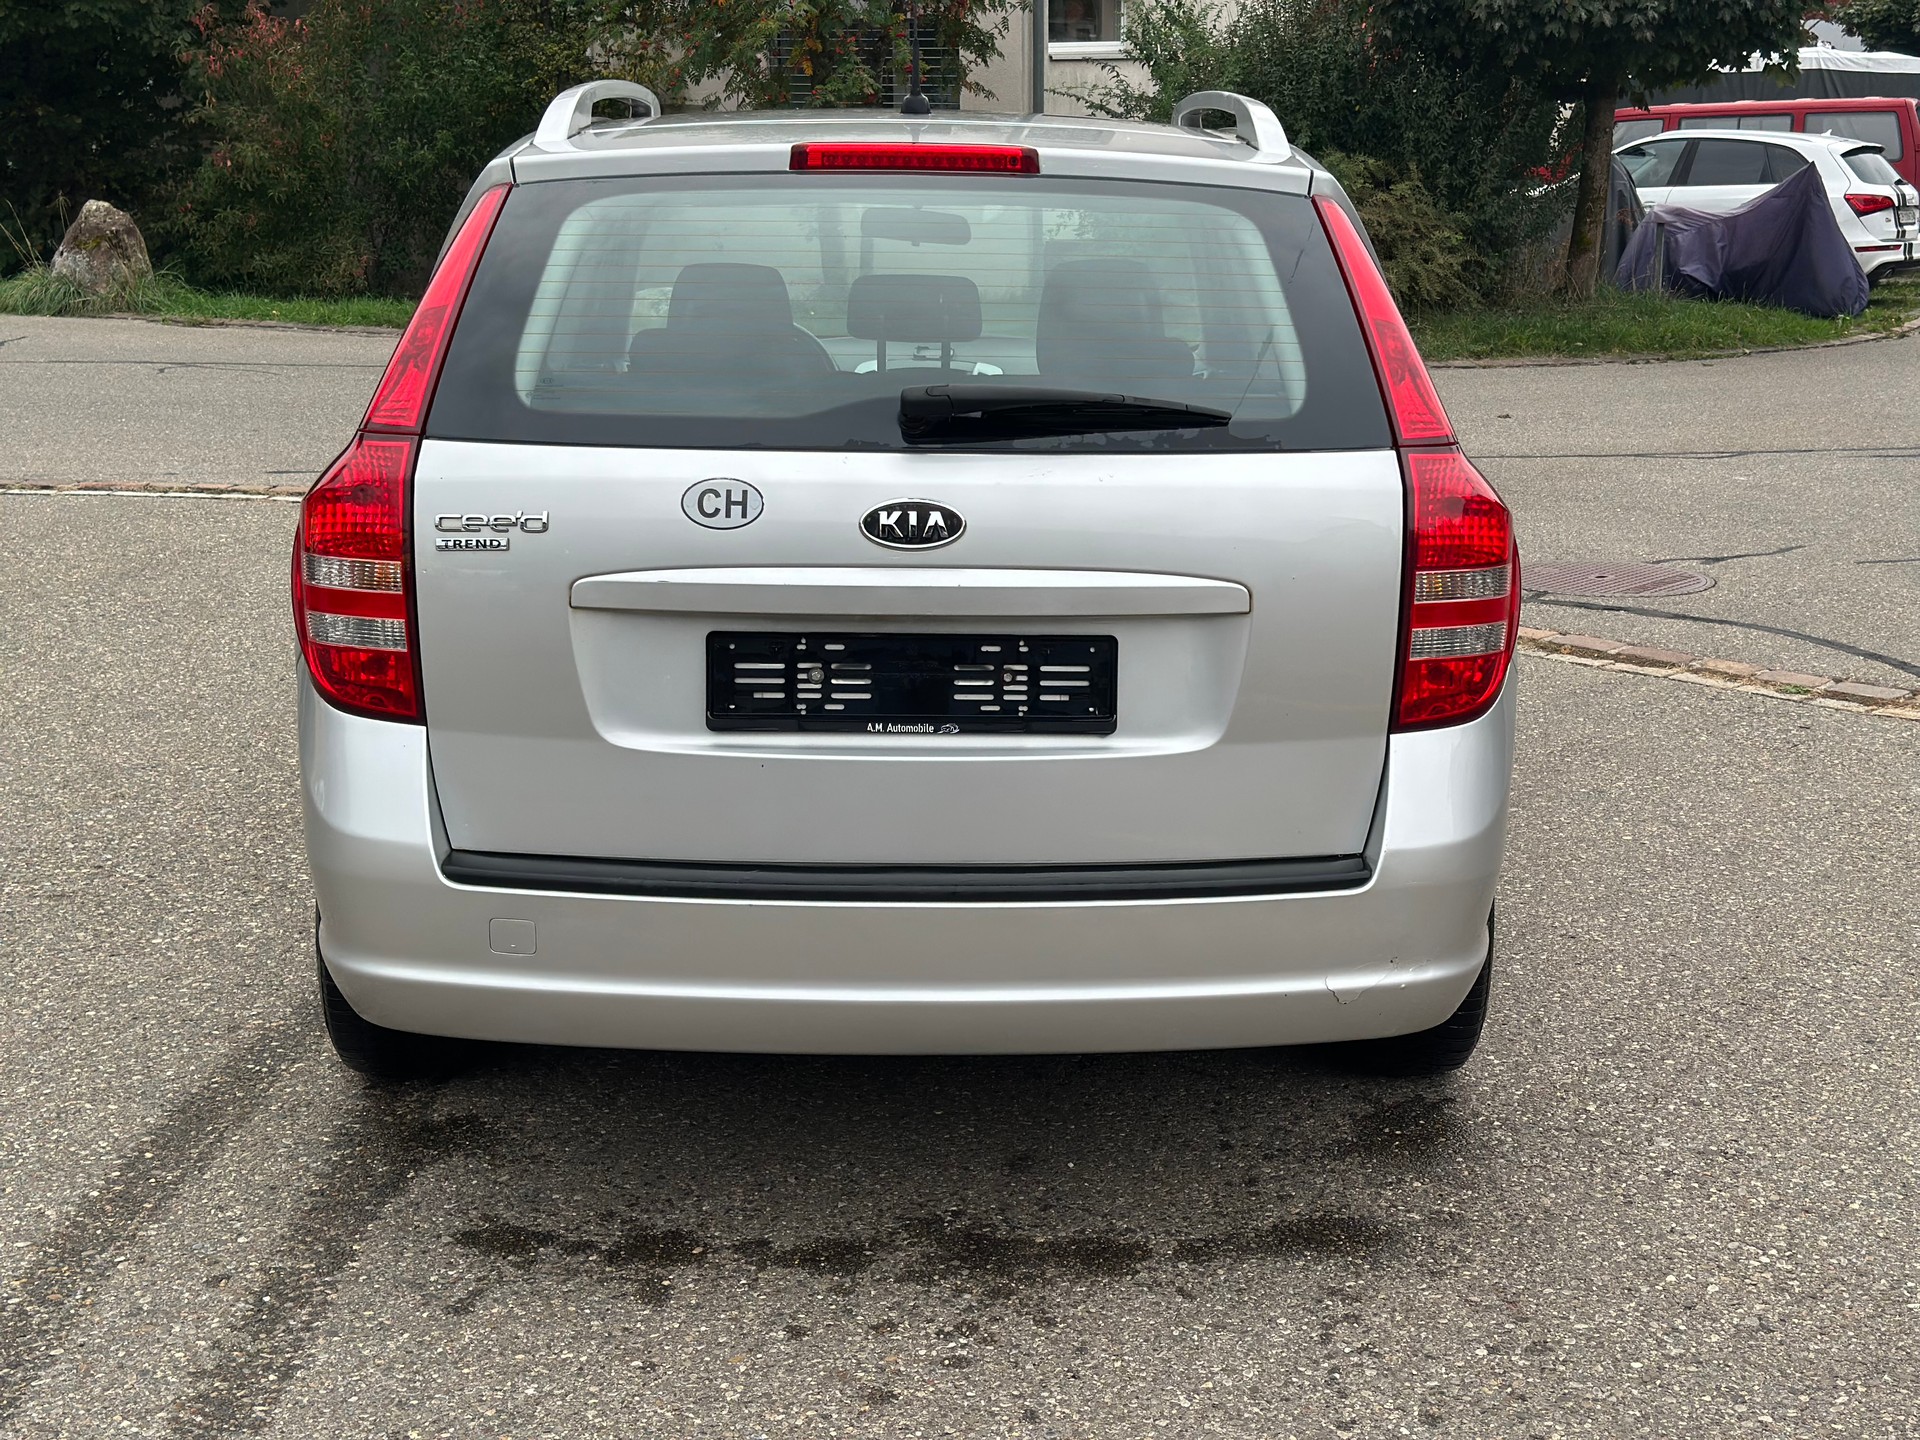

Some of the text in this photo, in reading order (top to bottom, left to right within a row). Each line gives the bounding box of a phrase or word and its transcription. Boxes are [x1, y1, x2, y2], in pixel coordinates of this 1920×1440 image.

[697, 488, 748, 519] CH
[877, 510, 949, 538] KIA
[441, 539, 502, 549] TREND
[866, 722, 935, 733] A.M. Automobile
